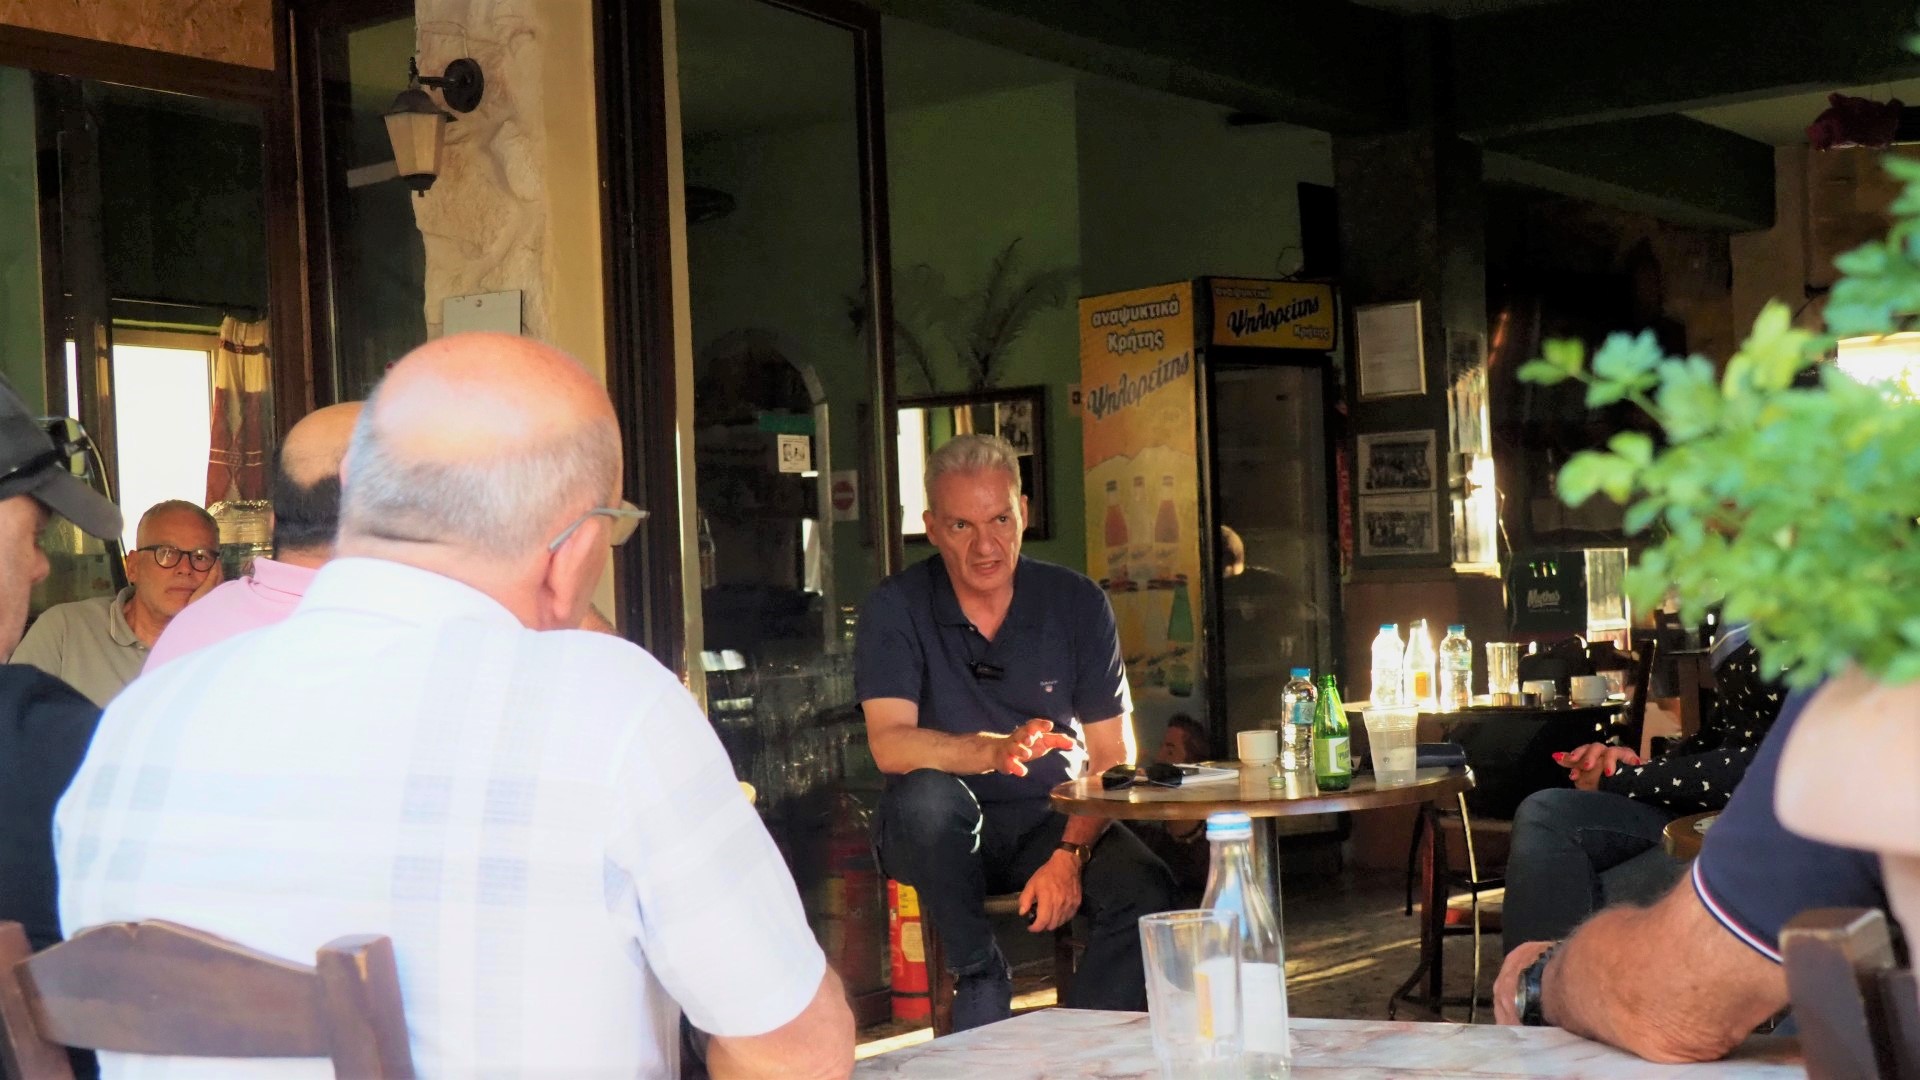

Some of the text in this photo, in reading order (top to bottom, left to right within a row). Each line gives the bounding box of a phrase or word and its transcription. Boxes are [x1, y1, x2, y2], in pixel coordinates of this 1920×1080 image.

[1092, 294, 1180, 328] αναψυκτικά
[1227, 296, 1320, 338] Ψηλορείτης
[1107, 329, 1165, 355] Κρήτης
[1087, 351, 1190, 421] Ψηλορείτης
